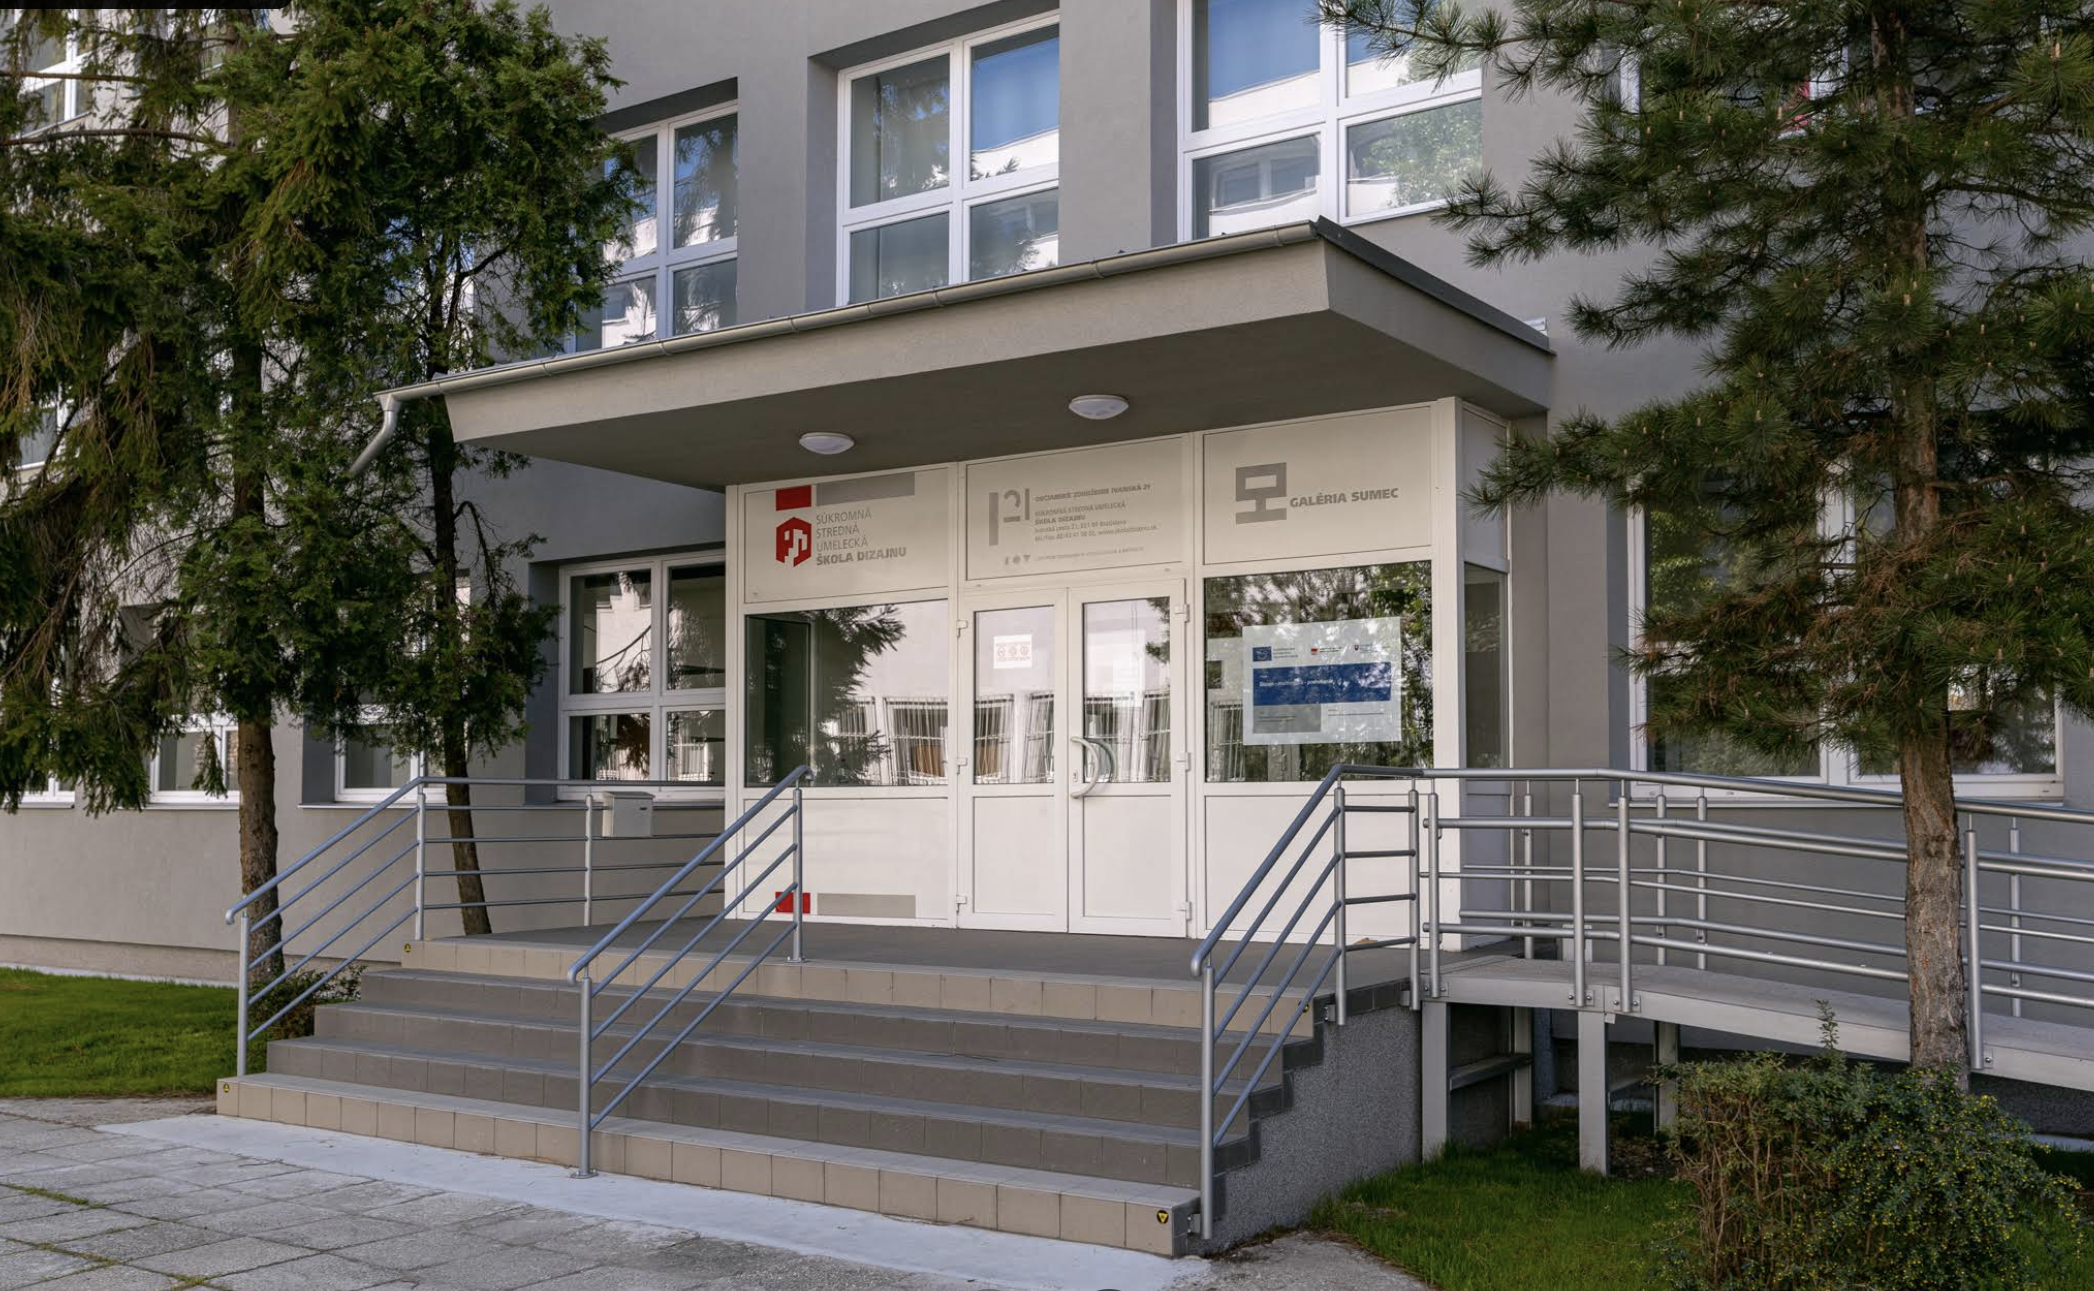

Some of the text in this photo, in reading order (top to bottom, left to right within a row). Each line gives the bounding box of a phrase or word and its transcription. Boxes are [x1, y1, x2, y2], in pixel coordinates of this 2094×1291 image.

[1290, 488, 1399, 508] GALÉRIA SUMEC
[816, 508, 871, 525] SÚKROMNÁ
[816, 523, 860, 539] STREDNÁ
[816, 535, 869, 552] UMELECKÁ
[816, 547, 907, 566] ŠKOLA DIZAJNU
